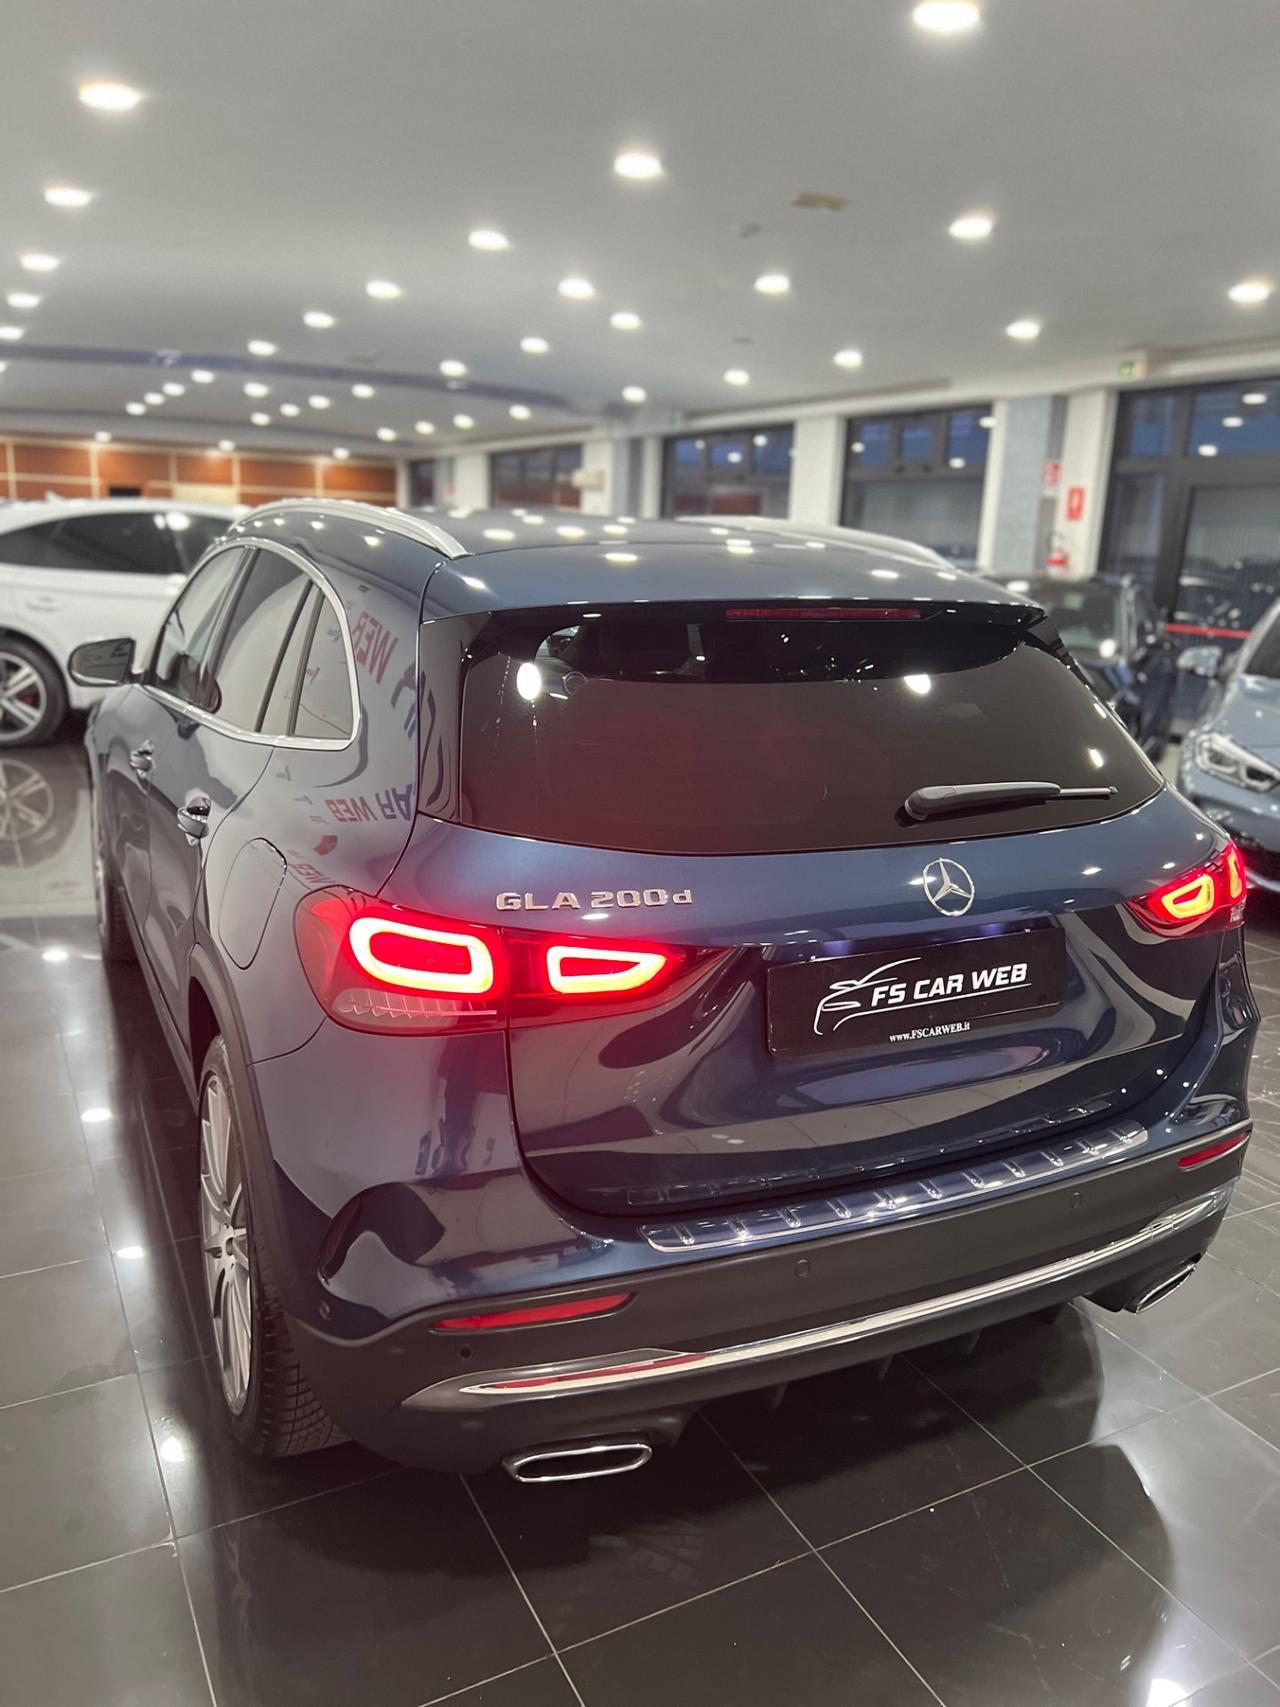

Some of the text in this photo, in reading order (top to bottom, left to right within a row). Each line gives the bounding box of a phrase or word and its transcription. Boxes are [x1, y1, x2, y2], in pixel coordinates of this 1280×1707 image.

[375, 783, 413, 821] AR
[496, 891, 581, 910] GLA
[870, 963, 1028, 1007] FS CAR WEB
[889, 1021, 971, 1043] www.FSCARWEB.it
